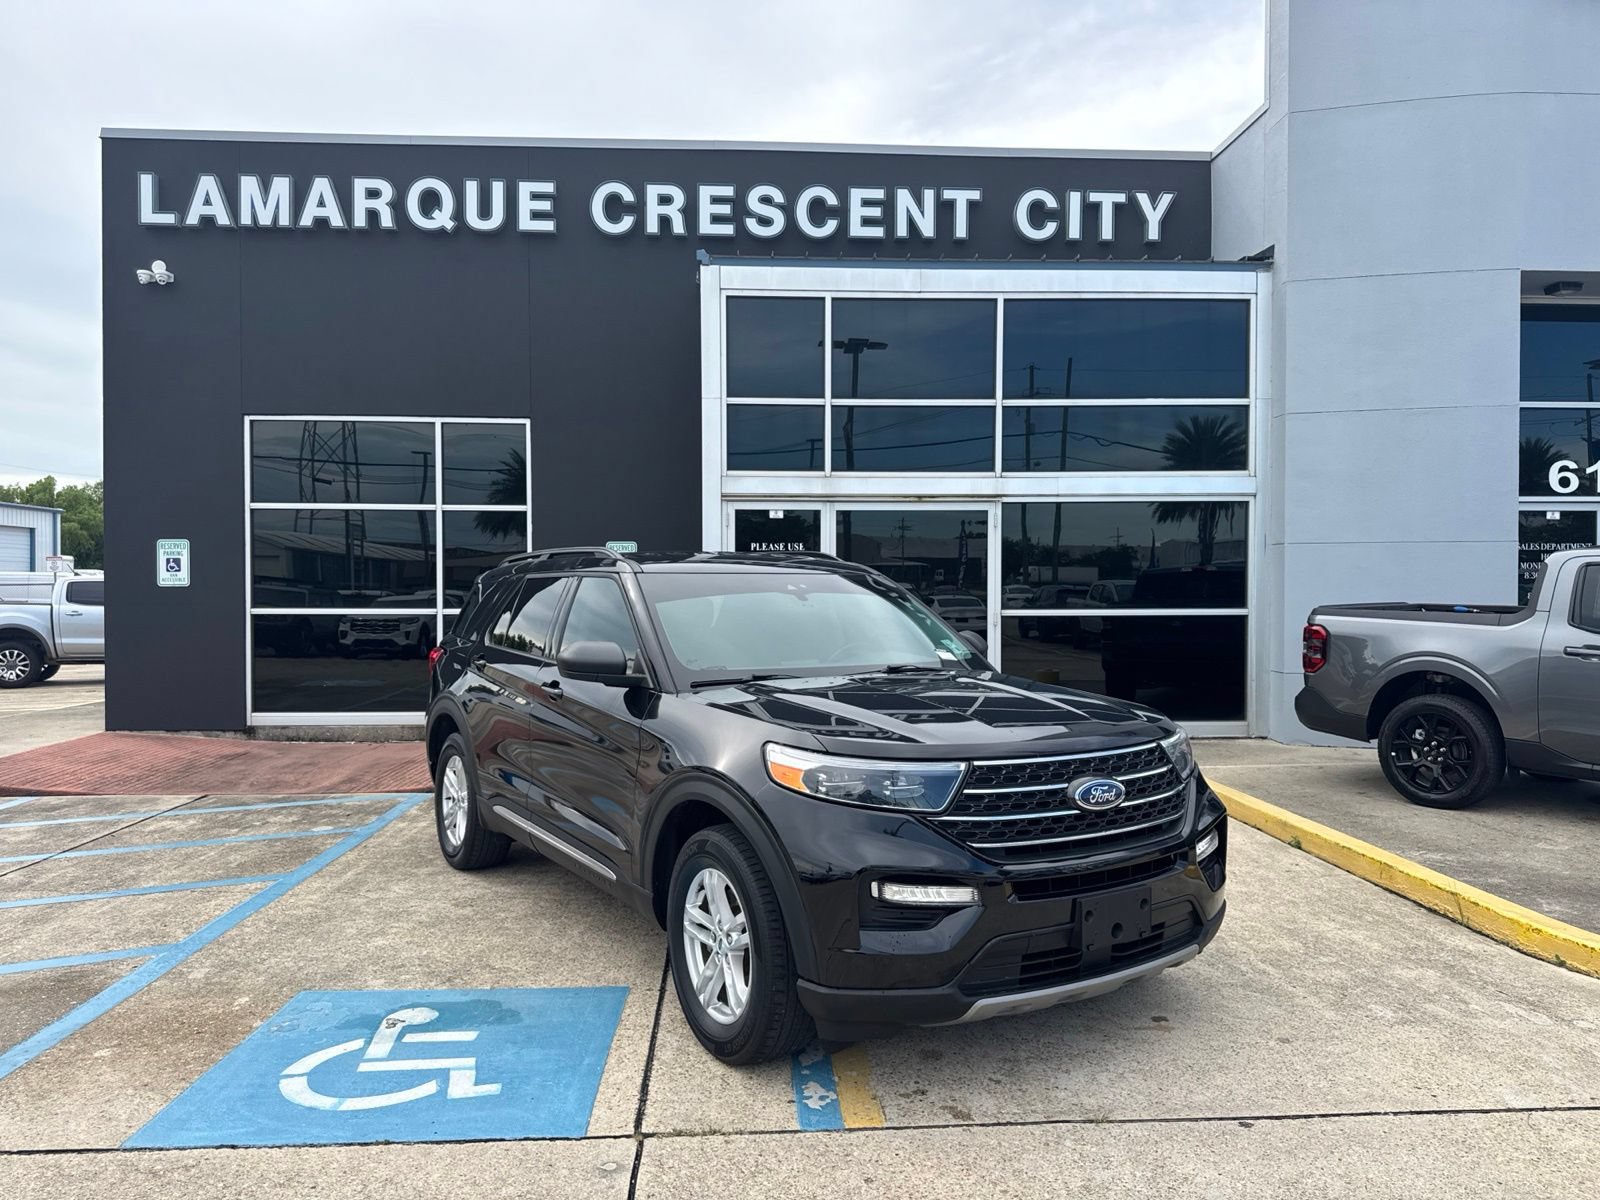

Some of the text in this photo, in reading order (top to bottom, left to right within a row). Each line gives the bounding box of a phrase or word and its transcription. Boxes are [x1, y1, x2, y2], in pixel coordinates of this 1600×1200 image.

[137, 171, 1176, 242] LAMARQUE CRESCENT CITY
[160, 542, 187, 550] RESERVED
[750, 542, 806, 551] PLEASE USE
[1090, 785, 1116, 803] Ford
